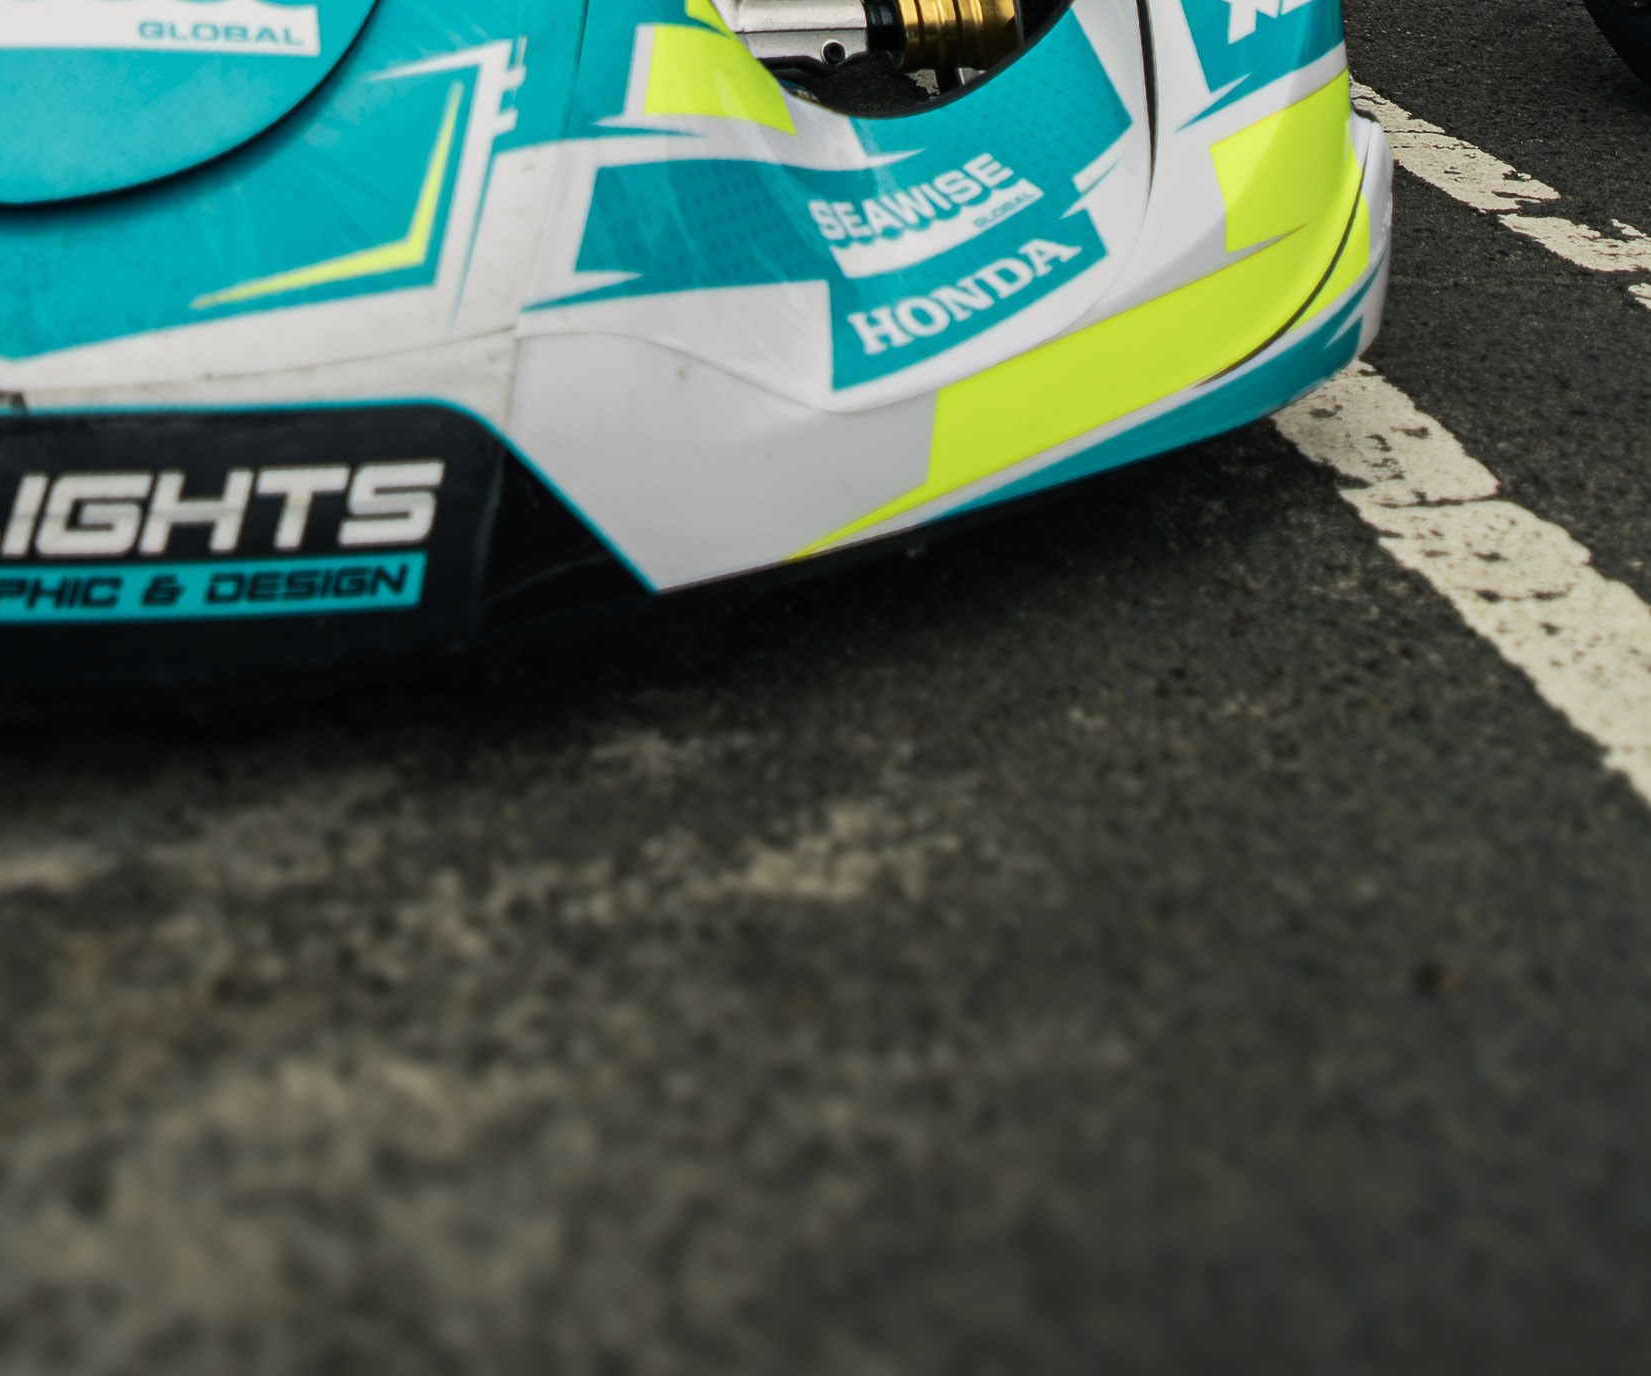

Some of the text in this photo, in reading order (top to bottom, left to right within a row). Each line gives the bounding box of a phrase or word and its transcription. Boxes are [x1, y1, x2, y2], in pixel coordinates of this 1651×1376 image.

[138, 20, 305, 46] GLOBAL
[808, 152, 1014, 242] SEAWISE
[846, 237, 1082, 356] HONDA
[139, 571, 185, 609] &
[204, 562, 411, 608] DESIGN
